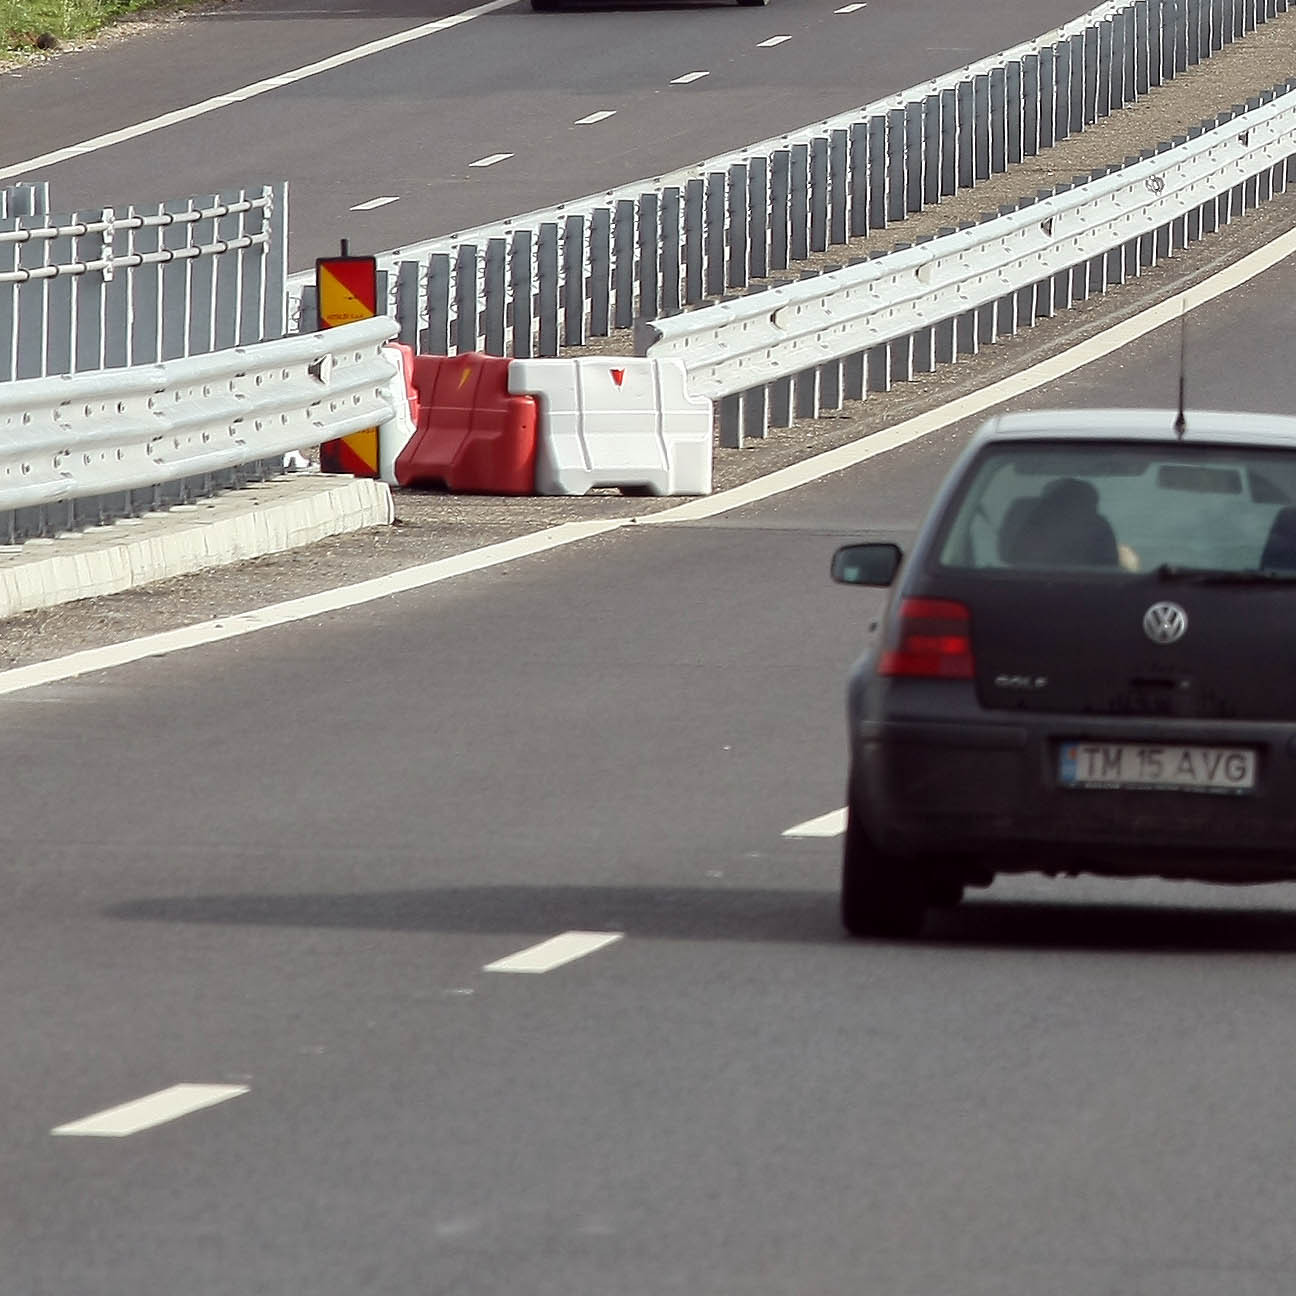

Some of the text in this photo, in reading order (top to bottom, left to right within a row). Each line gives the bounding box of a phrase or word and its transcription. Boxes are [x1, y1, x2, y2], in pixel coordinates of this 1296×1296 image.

[1083, 748, 1247, 782] TM 15 AVG
